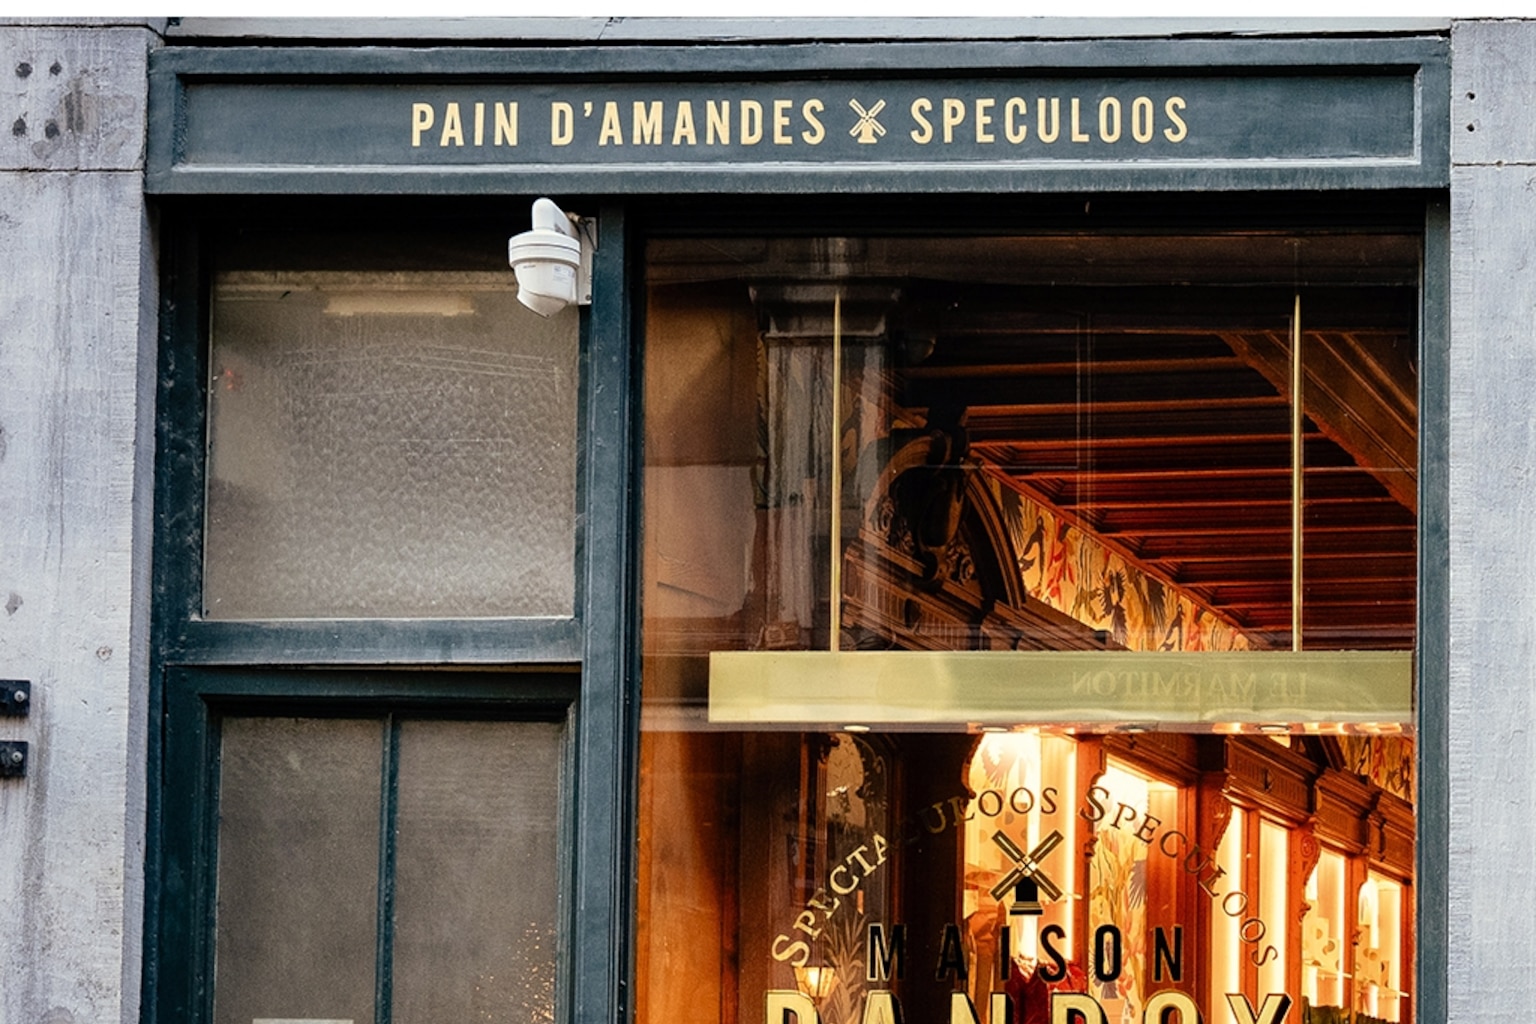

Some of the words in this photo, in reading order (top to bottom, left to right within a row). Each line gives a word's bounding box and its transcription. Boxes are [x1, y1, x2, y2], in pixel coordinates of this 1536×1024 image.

[411, 102, 520, 148] PAIN
[551, 99, 827, 147] D'AMANDES
[910, 96, 1189, 145] SPECULOOS
[1079, 785, 1279, 969] SPECULOOS
[867, 923, 1185, 982] MAISON
